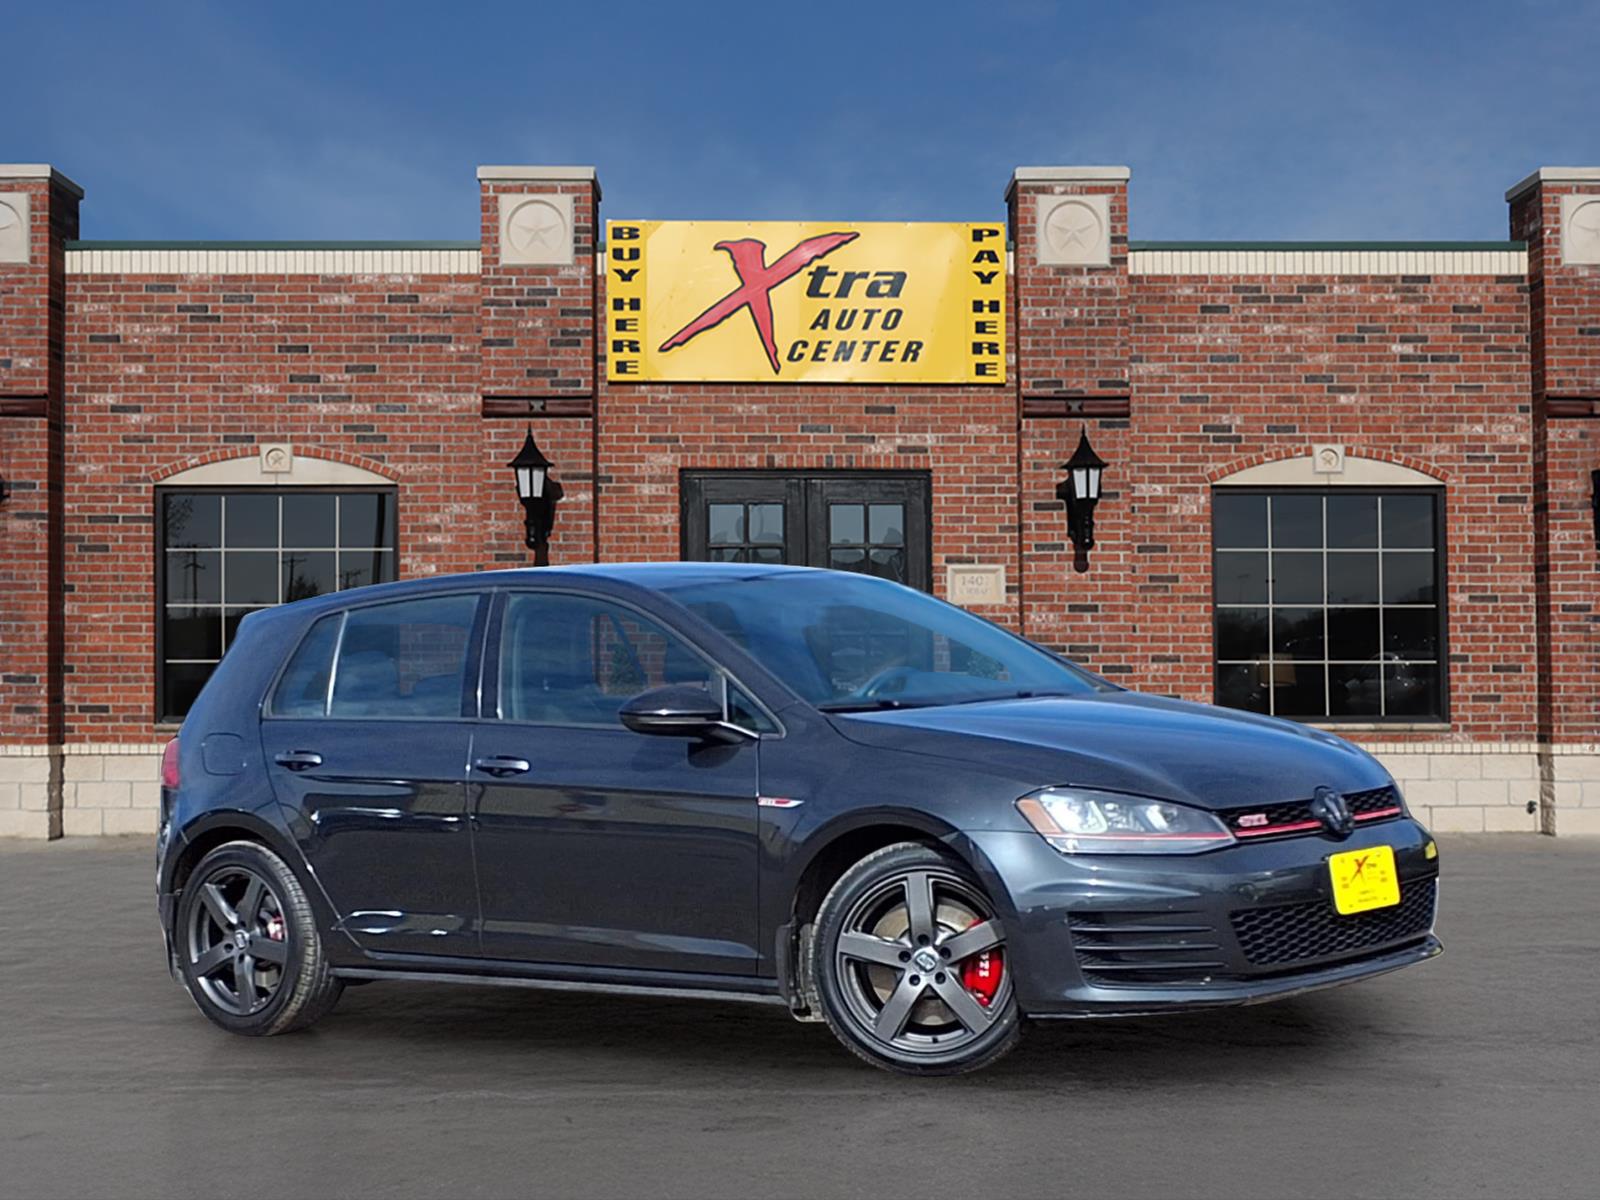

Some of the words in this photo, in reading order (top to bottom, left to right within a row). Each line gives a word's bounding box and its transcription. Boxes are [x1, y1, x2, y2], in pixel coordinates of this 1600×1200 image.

[612, 227, 640, 282] BUY
[972, 229, 1000, 284] PAY
[658, 231, 907, 375] Xtra
[809, 308, 904, 331] AUTO
[612, 298, 640, 375] HERE
[786, 340, 924, 363] CENTER
[972, 300, 1000, 377] HERE
